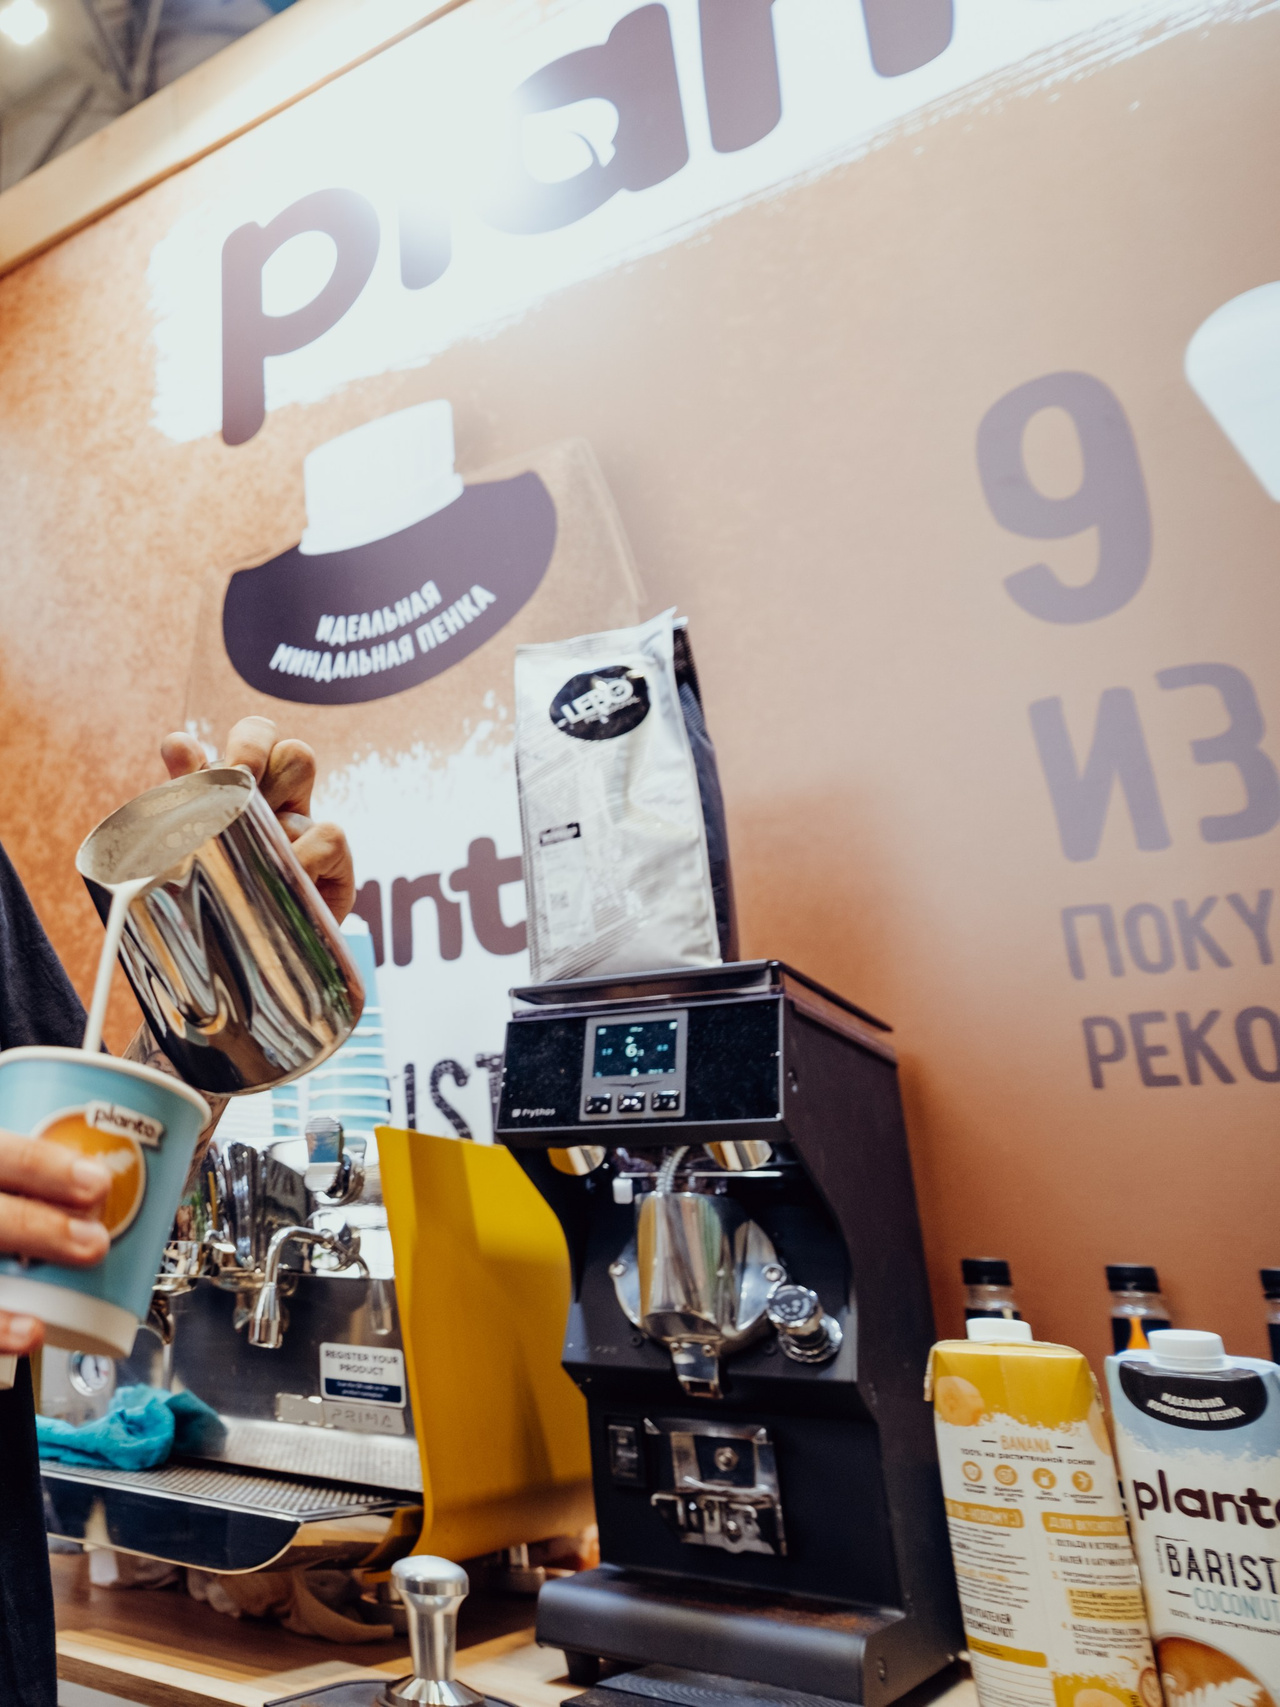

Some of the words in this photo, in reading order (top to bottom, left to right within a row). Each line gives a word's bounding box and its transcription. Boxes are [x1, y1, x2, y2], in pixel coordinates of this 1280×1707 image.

[976, 370, 1153, 626] 9
[269, 633, 416, 683] МИНДАЛЬНАЯ
[415, 583, 497, 653] ПЕНКА
[314, 579, 442, 647] ИДЕАЛЬНАЯ
[1027, 661, 1280, 863] ИЗ
[1061, 887, 1275, 981] ПОКУ
[1081, 1005, 1280, 1091] РЕКО
[94, 1102, 156, 1138] planto
[325, 1350, 368, 1361] REGISTER
[371, 1353, 399, 1364] YOUR
[339, 1364, 385, 1376] PRODUCT
[1000, 1434, 1054, 1454] BANANA
[1133, 1469, 1280, 1530] plant
[1165, 1543, 1280, 1595] BARIST
[1193, 1587, 1280, 1624] COCONUT
